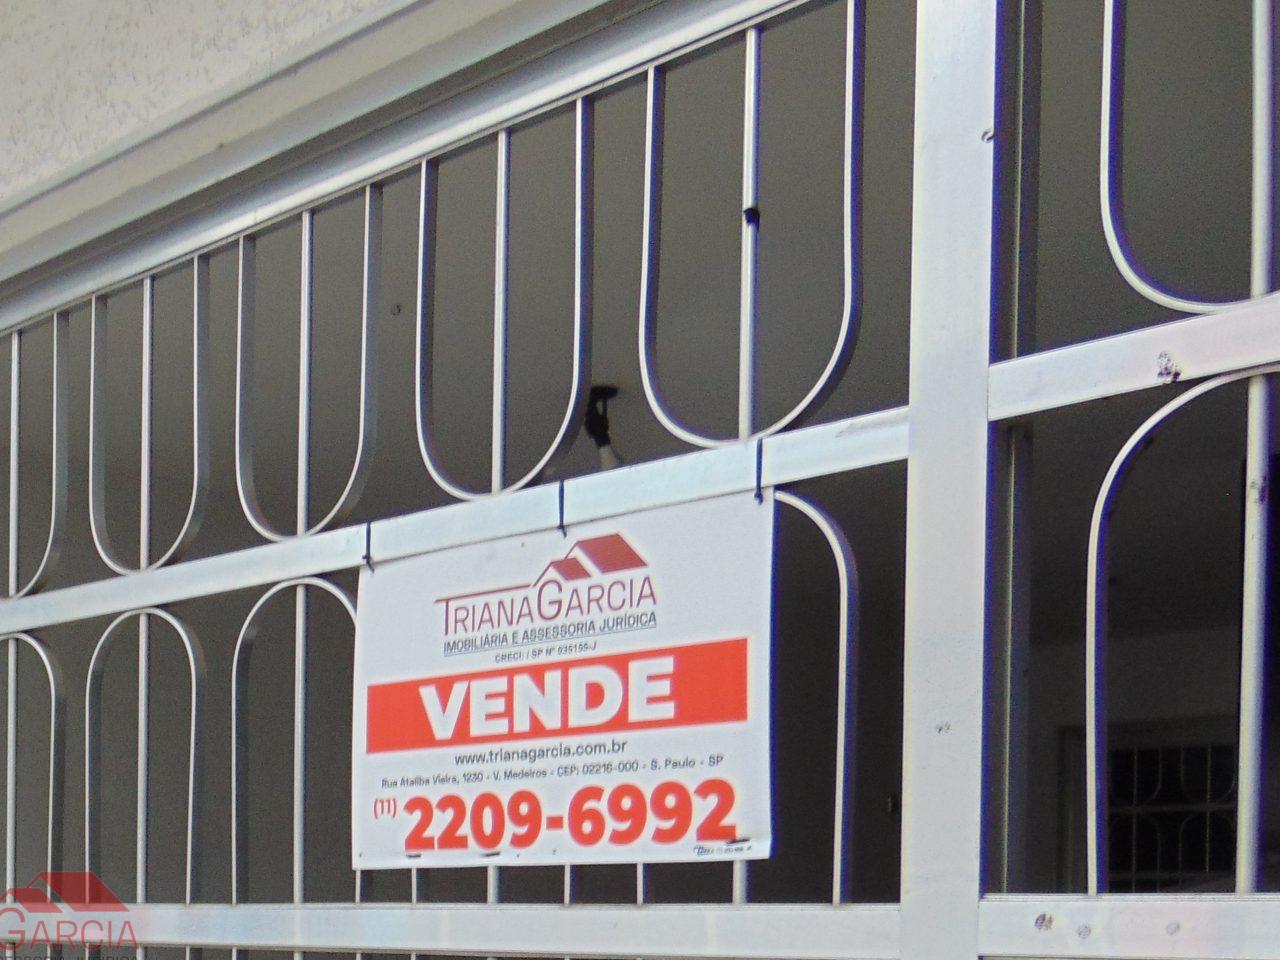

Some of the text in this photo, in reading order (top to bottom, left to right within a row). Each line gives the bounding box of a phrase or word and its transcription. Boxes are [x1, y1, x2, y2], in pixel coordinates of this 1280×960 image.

[443, 611, 657, 654] IMOBILIÁRIA E ASSESSORIA JURÍDICA
[418, 656, 675, 741] VENDE
[381, 778, 398, 789] Rua
[504, 767, 548, 781] Medeiros
[557, 765, 579, 777] CEP:
[582, 760, 639, 775] 02216-000
[664, 757, 696, 770] Paulo
[708, 754, 724, 767] SP
[454, 738, 628, 766] www.trianagarcia.com.br
[373, 777, 737, 851] (11) 2209-6992
